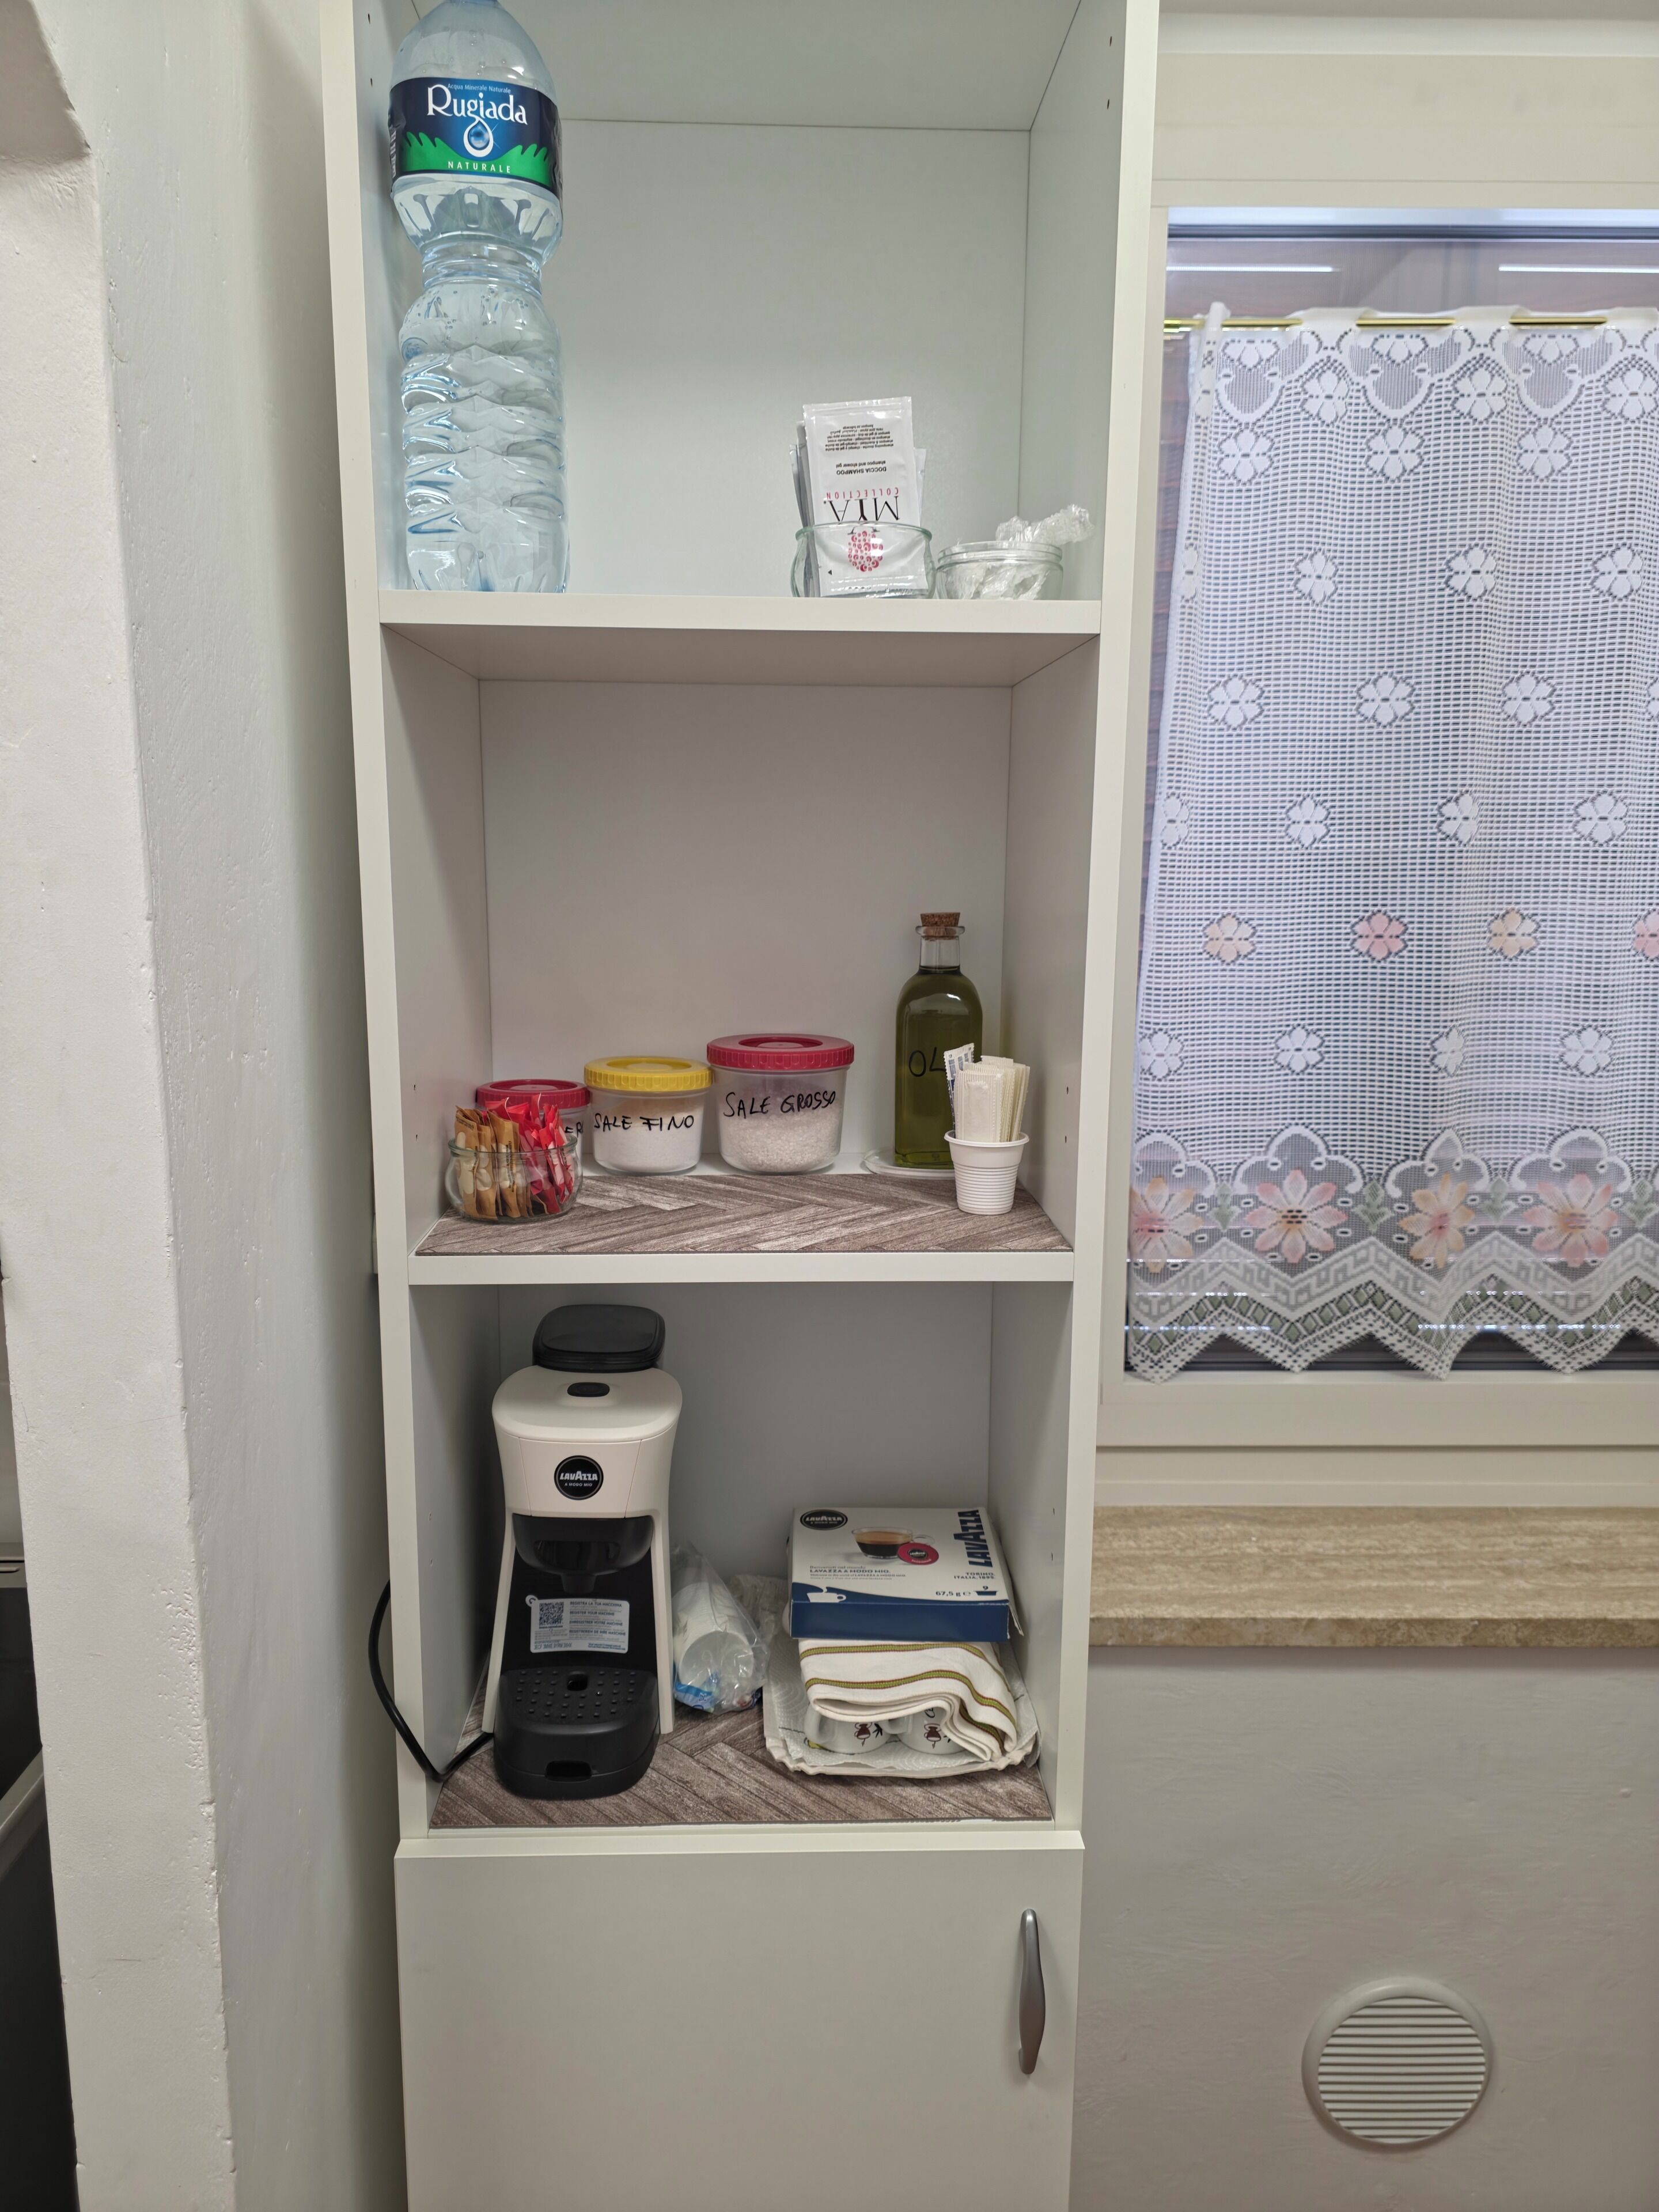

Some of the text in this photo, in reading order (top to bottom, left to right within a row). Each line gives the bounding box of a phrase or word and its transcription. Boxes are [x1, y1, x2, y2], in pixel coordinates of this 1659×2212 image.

[427, 84, 528, 129] Rugiada
[448, 161, 511, 173] NATURALE
[827, 487, 899, 499] COLLECTION
[724, 1090, 836, 1119] SALE GROSSO
[594, 1113, 694, 1132] SALE FINO
[559, 1471, 598, 1481] LAVAZZA
[953, 1509, 993, 1567] LAVAZZA
